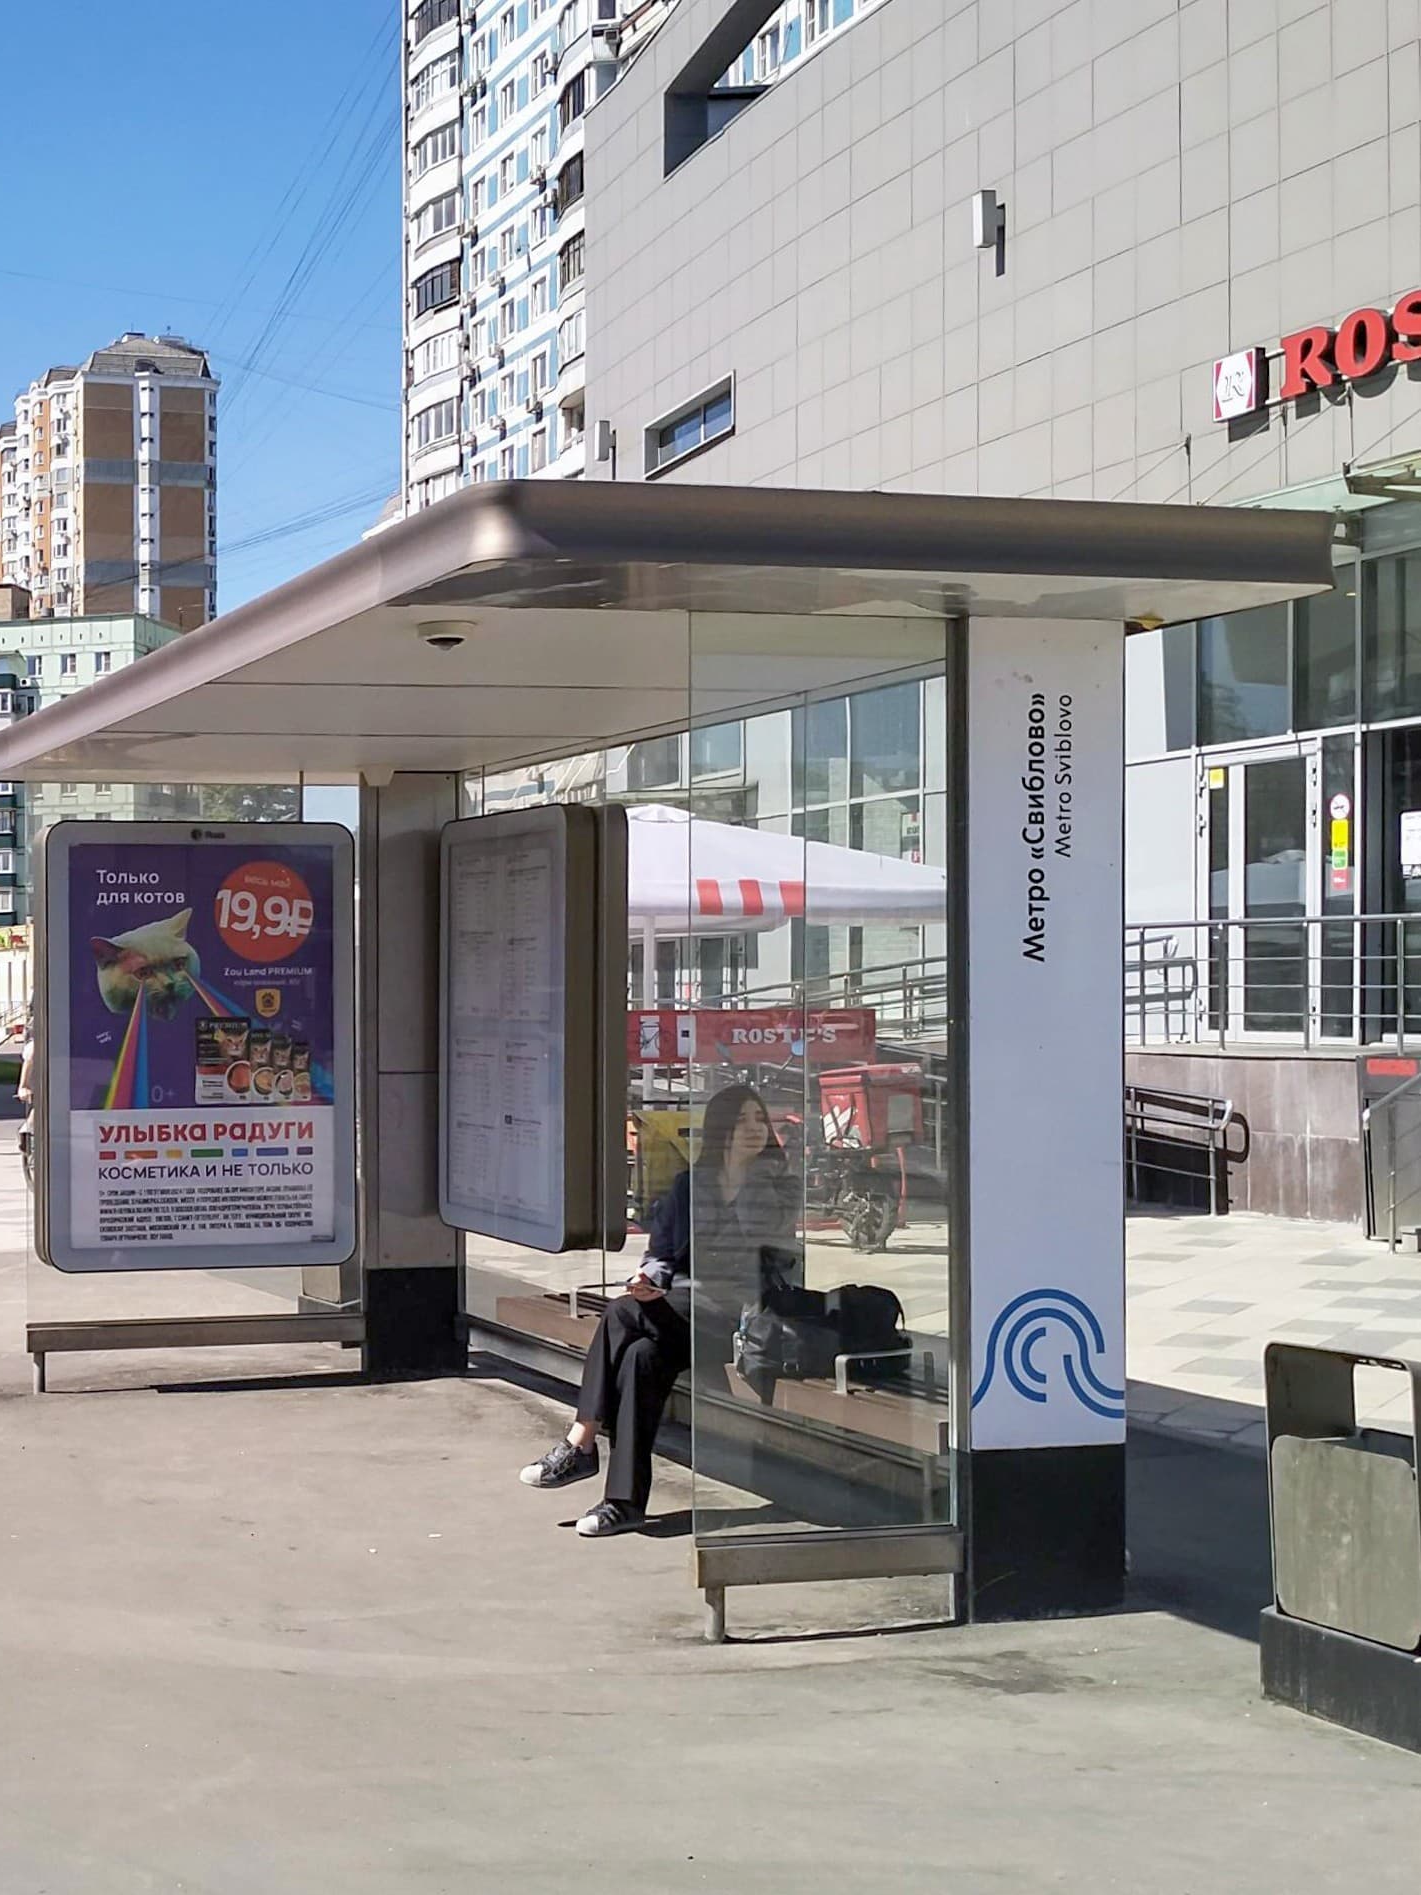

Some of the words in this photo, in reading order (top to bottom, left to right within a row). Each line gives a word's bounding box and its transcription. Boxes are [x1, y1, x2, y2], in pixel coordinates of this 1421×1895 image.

[1054, 694, 1072, 785] Sviblovo
[1021, 693, 1045, 860] «Свиблово»
[1054, 791, 1072, 858] Metro
[96, 869, 160, 885] Только
[96, 892, 130, 906] для
[134, 892, 185, 904] котов
[1022, 868, 1050, 963] Метро
[98, 1165, 200, 1180] КОСМЕТИКА
[205, 1164, 217, 1177] И
[222, 1163, 243, 1176] НЕ
[249, 1162, 314, 1176] ТОЛЬКО
